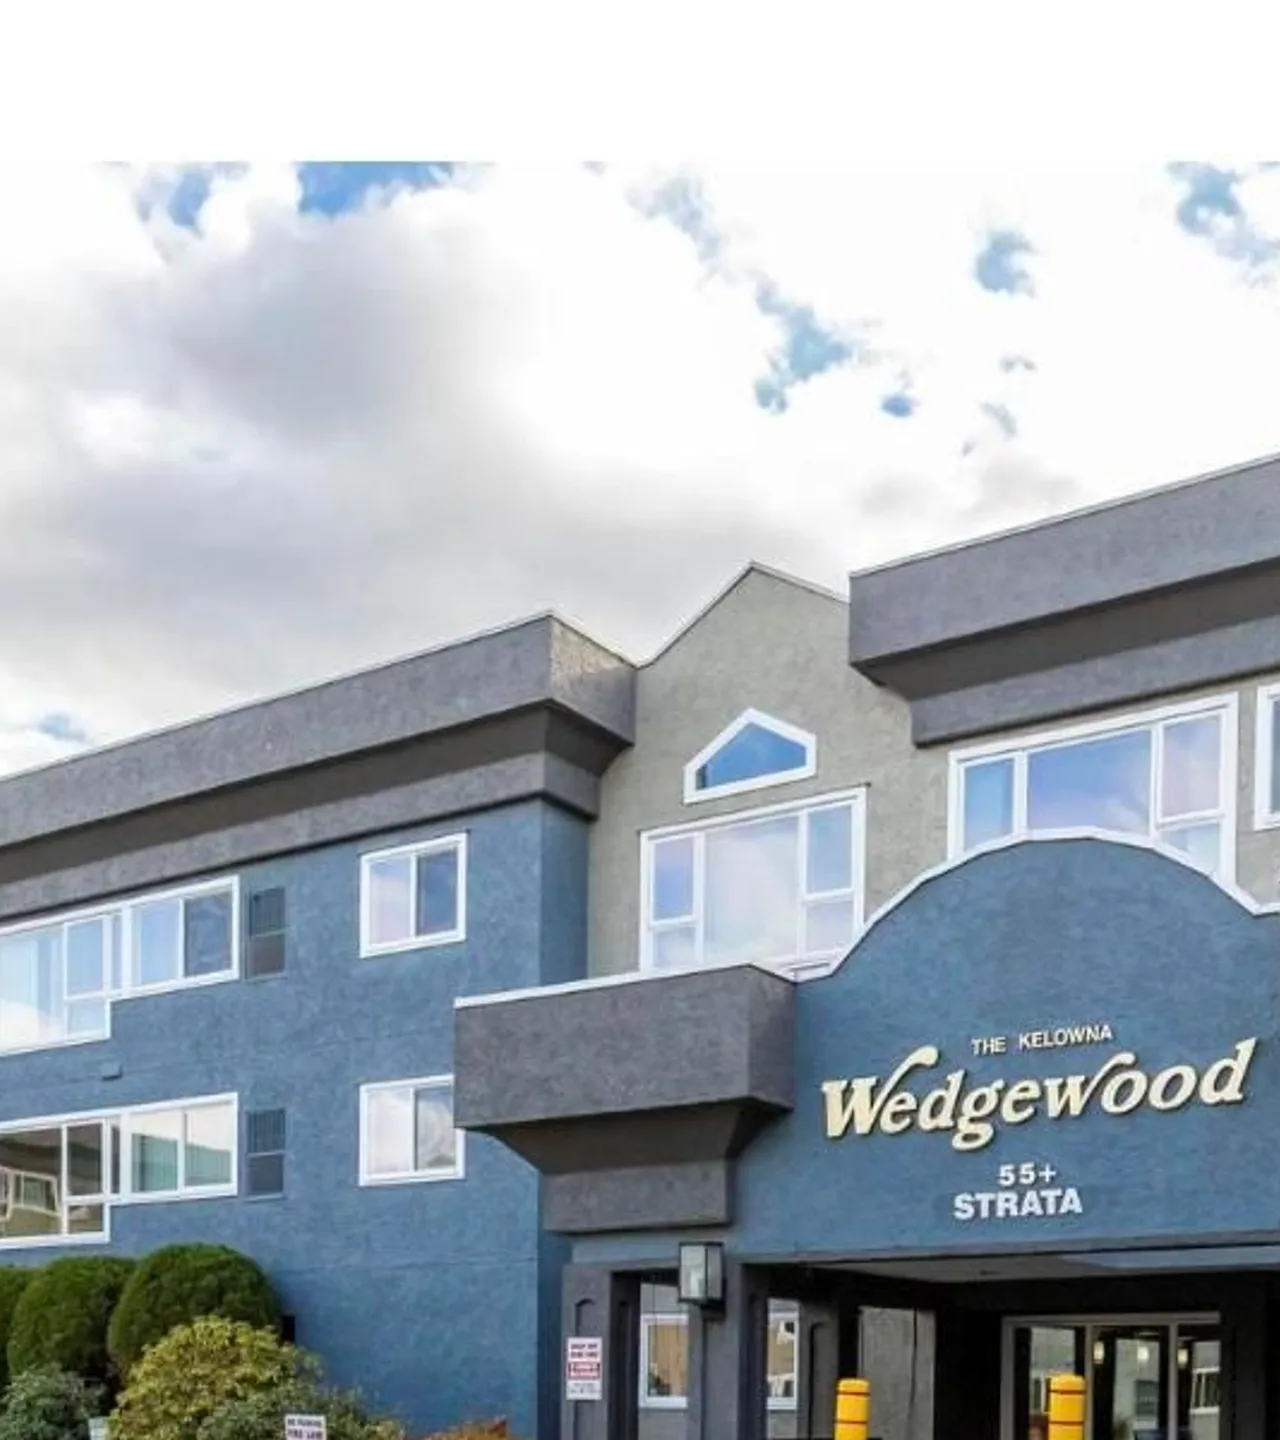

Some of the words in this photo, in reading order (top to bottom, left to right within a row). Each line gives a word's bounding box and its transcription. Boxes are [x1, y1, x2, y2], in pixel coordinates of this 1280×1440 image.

[971, 1037, 1006, 1056] THE
[1018, 1024, 1114, 1051] KELOWNA
[822, 1037, 1258, 1151] Wedgewood
[998, 1162, 1057, 1186] 55+
[953, 1187, 1083, 1220] STRATA
